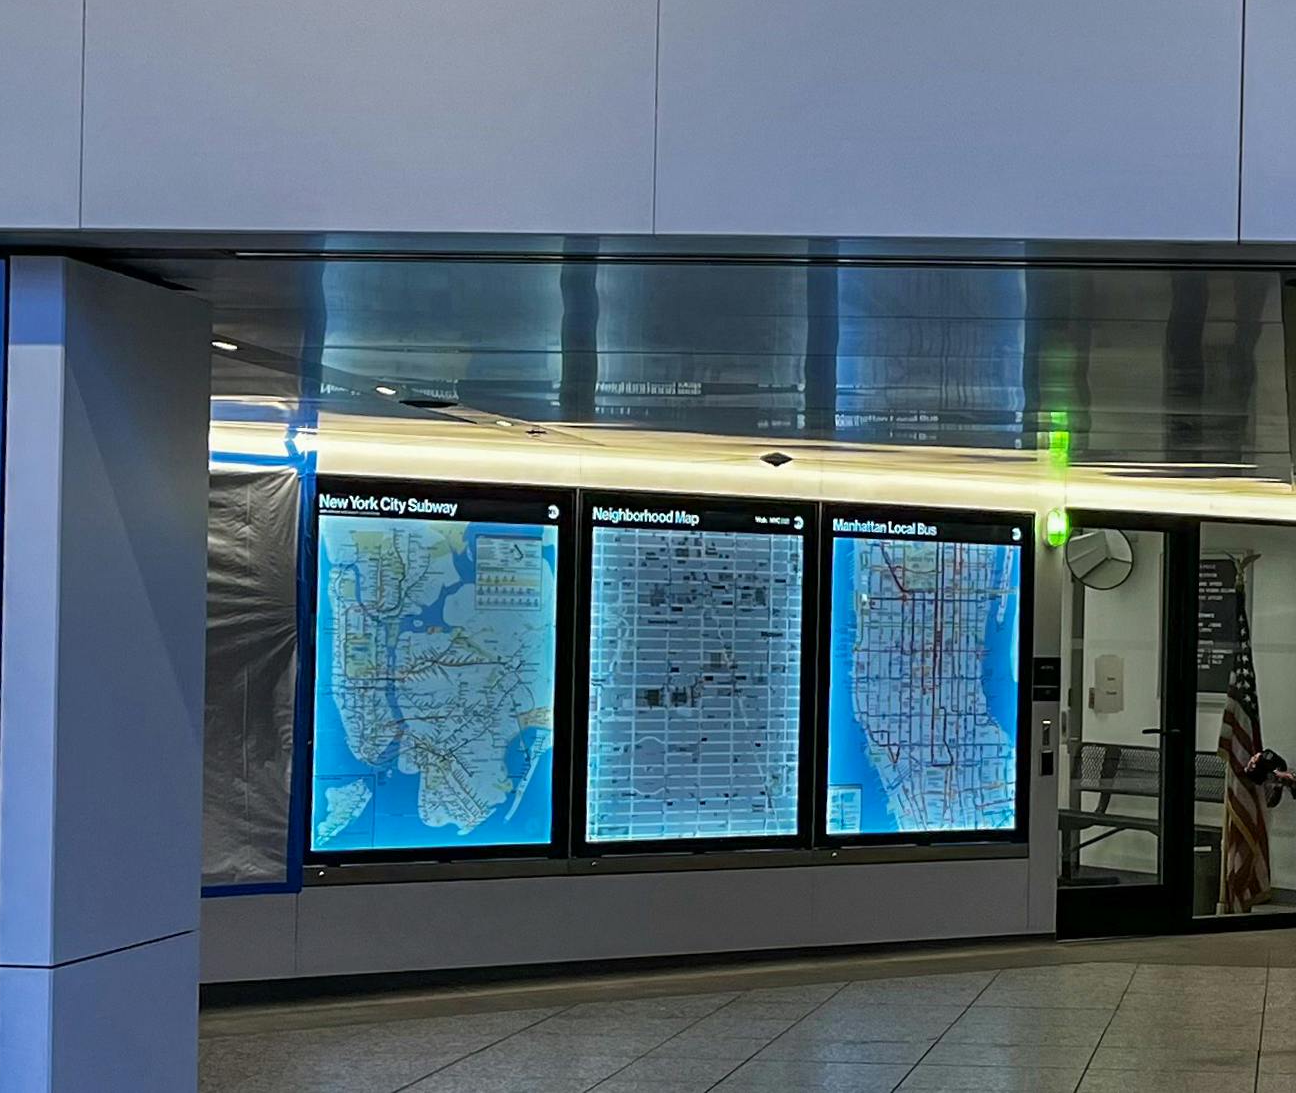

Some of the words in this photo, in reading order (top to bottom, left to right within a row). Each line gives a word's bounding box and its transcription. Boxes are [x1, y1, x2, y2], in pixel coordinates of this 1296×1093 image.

[318, 494, 349, 510] New
[349, 495, 380, 511] York
[380, 497, 407, 514] City
[408, 498, 458, 517] Subway
[592, 506, 674, 524] Neighborhood
[675, 510, 700, 526] Map
[833, 518, 887, 534] Manhattan
[888, 521, 916, 535] Local
[917, 523, 938, 536] Bus
